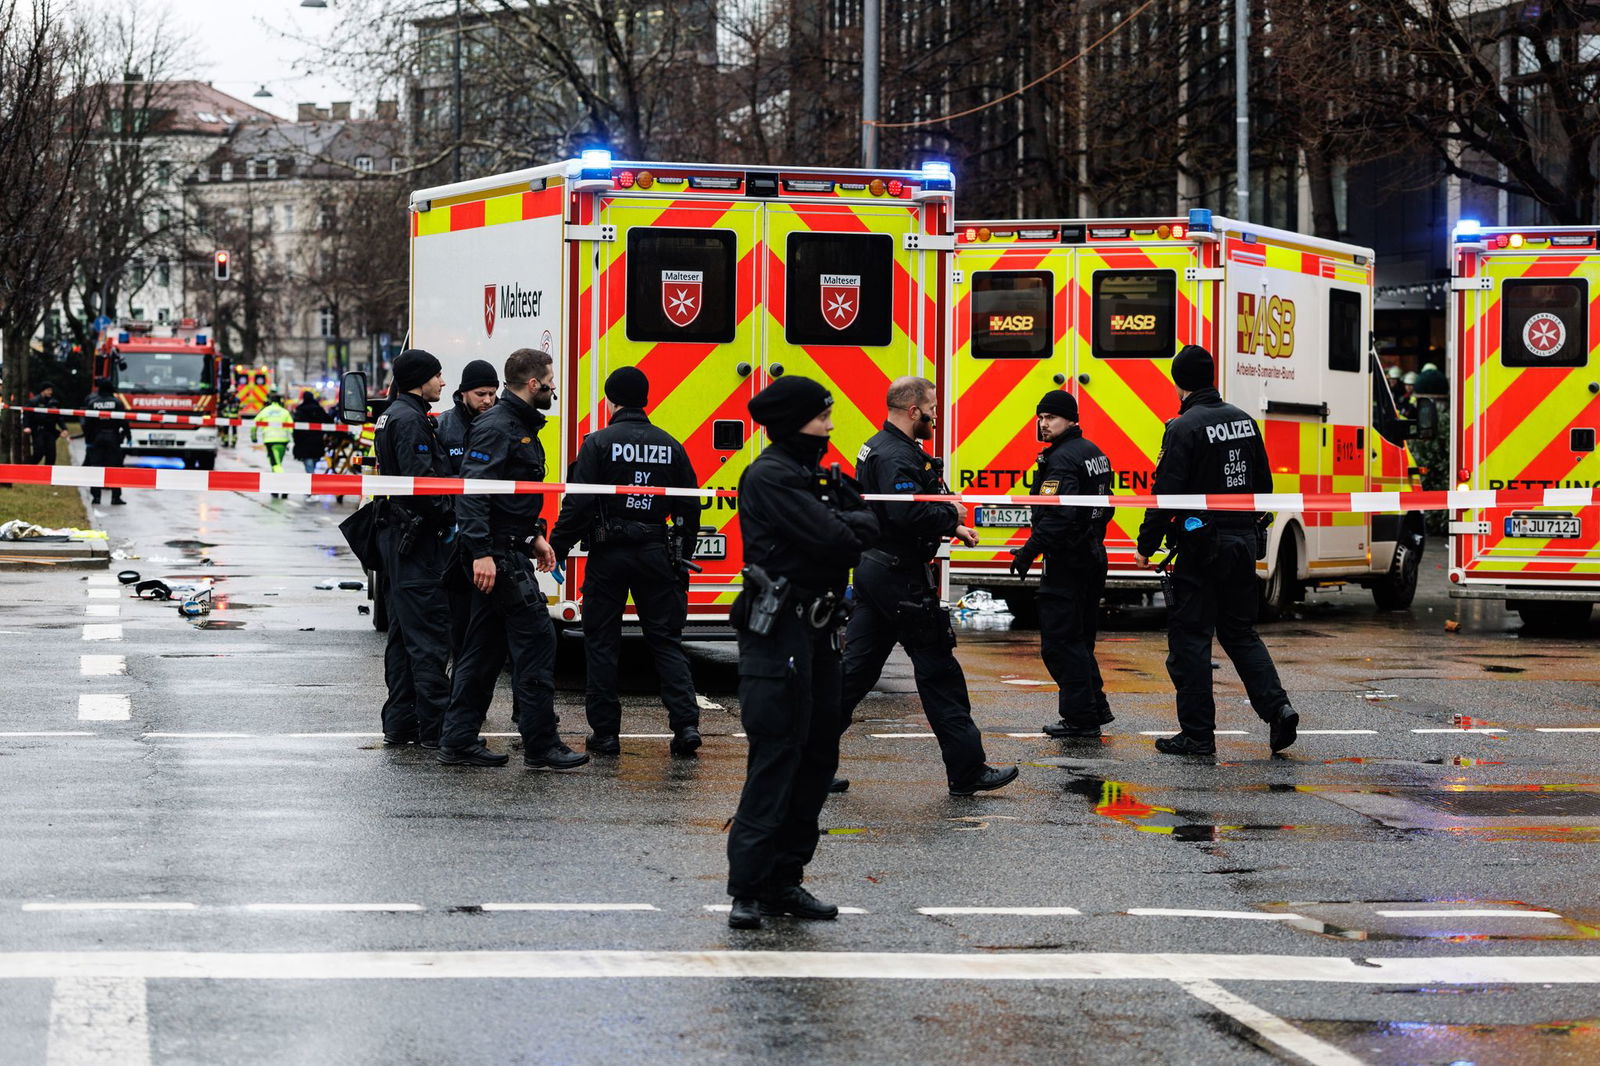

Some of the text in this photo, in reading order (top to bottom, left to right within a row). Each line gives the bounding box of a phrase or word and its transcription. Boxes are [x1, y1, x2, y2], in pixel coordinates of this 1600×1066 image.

[665, 272, 700, 281] Malteser
[823, 276, 858, 285] Malteser
[501, 282, 542, 319] Malteser
[1000, 315, 1034, 331] ASB
[1121, 315, 1156, 331] ASB
[1249, 295, 1296, 359] ASB
[93, 401, 116, 409] POLIZEI
[133, 397, 192, 407] FEUERWEHR
[1205, 419, 1256, 444] POLIZEI
[449, 447, 464, 456] POL
[611, 442, 673, 465] POLIZEI
[1229, 448, 1241, 462] BY
[1084, 455, 1110, 477] POLIZEI
[1224, 460, 1247, 475] 6246
[634, 471, 651, 484] BY
[1226, 473, 1246, 488] BeSi
[625, 496, 652, 511] BeSi
[982, 510, 1032, 522] M AS 71
[1512, 520, 1578, 533] M JU 7121
